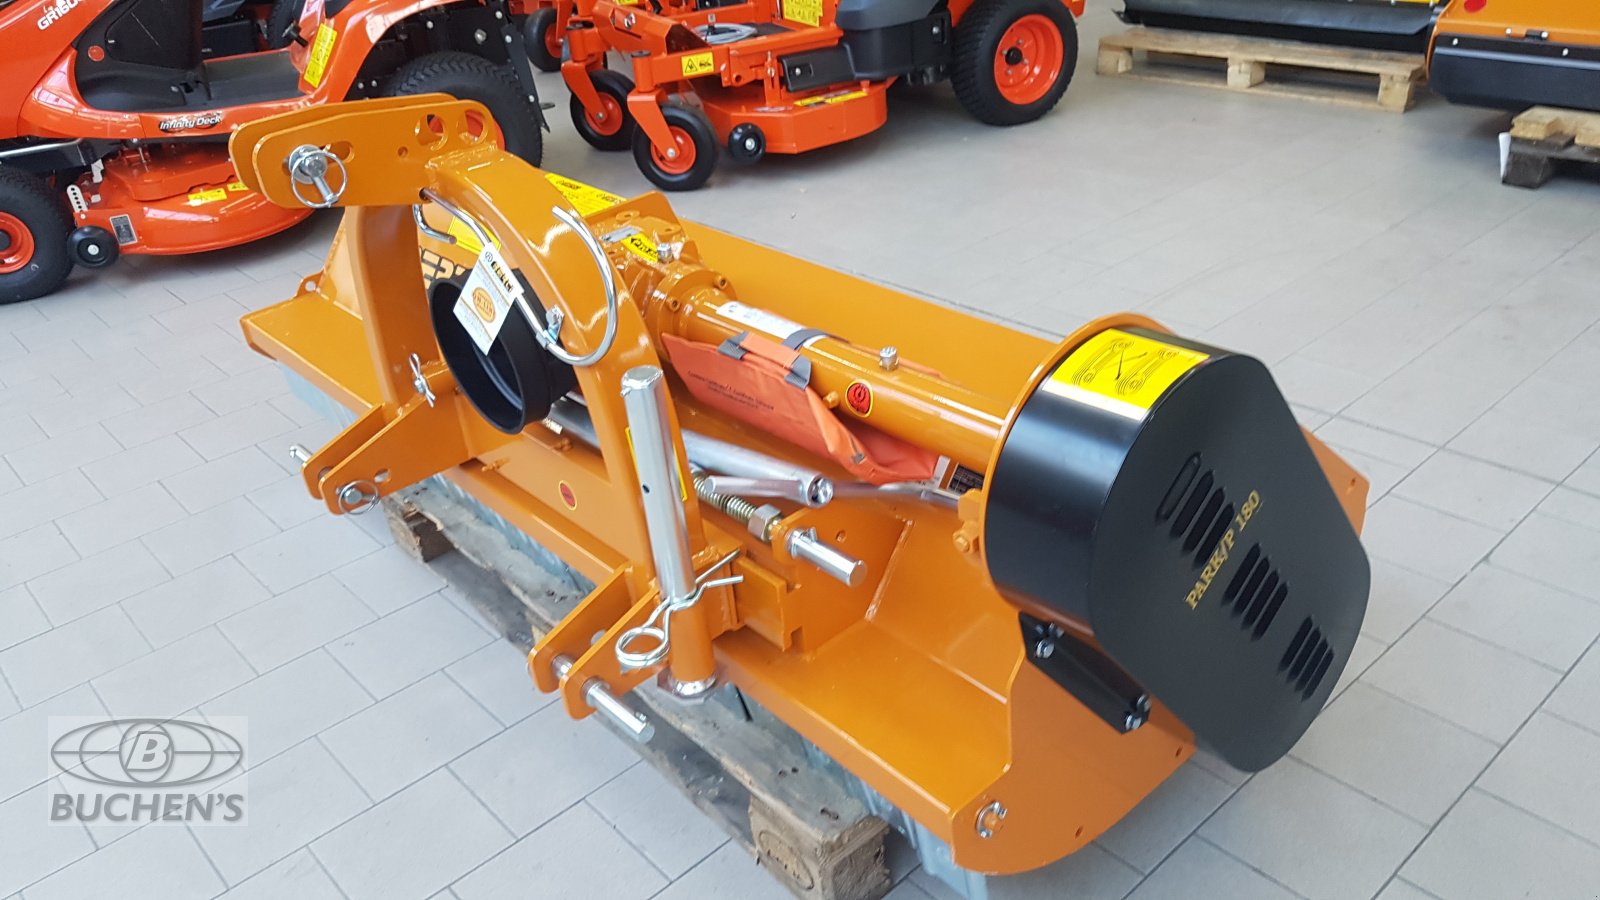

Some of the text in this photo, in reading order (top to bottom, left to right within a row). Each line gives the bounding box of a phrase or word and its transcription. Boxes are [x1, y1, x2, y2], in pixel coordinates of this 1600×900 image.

[160, 115, 221, 129] Infinity Deck
[1185, 490, 1260, 610] PARK/P 180
